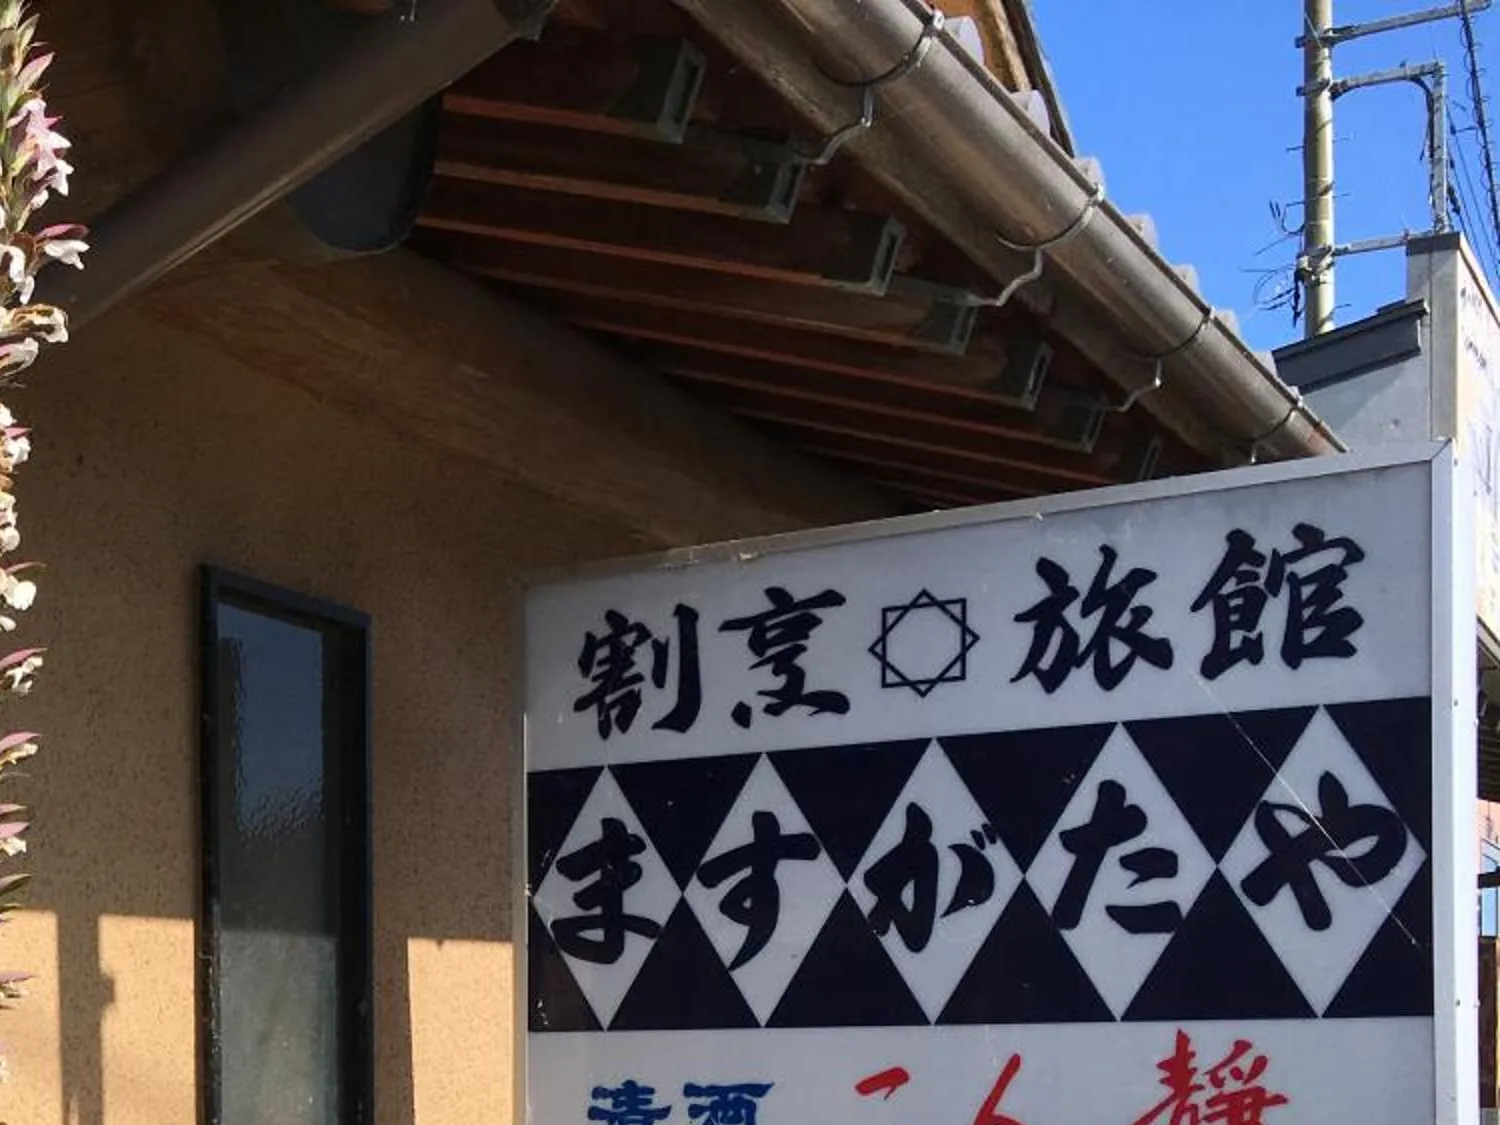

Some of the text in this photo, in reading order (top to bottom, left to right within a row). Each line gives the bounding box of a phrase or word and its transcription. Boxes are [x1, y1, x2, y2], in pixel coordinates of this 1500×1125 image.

[573, 522, 1367, 741] 割烹 旅館
[548, 772, 1408, 972] ますがたや
